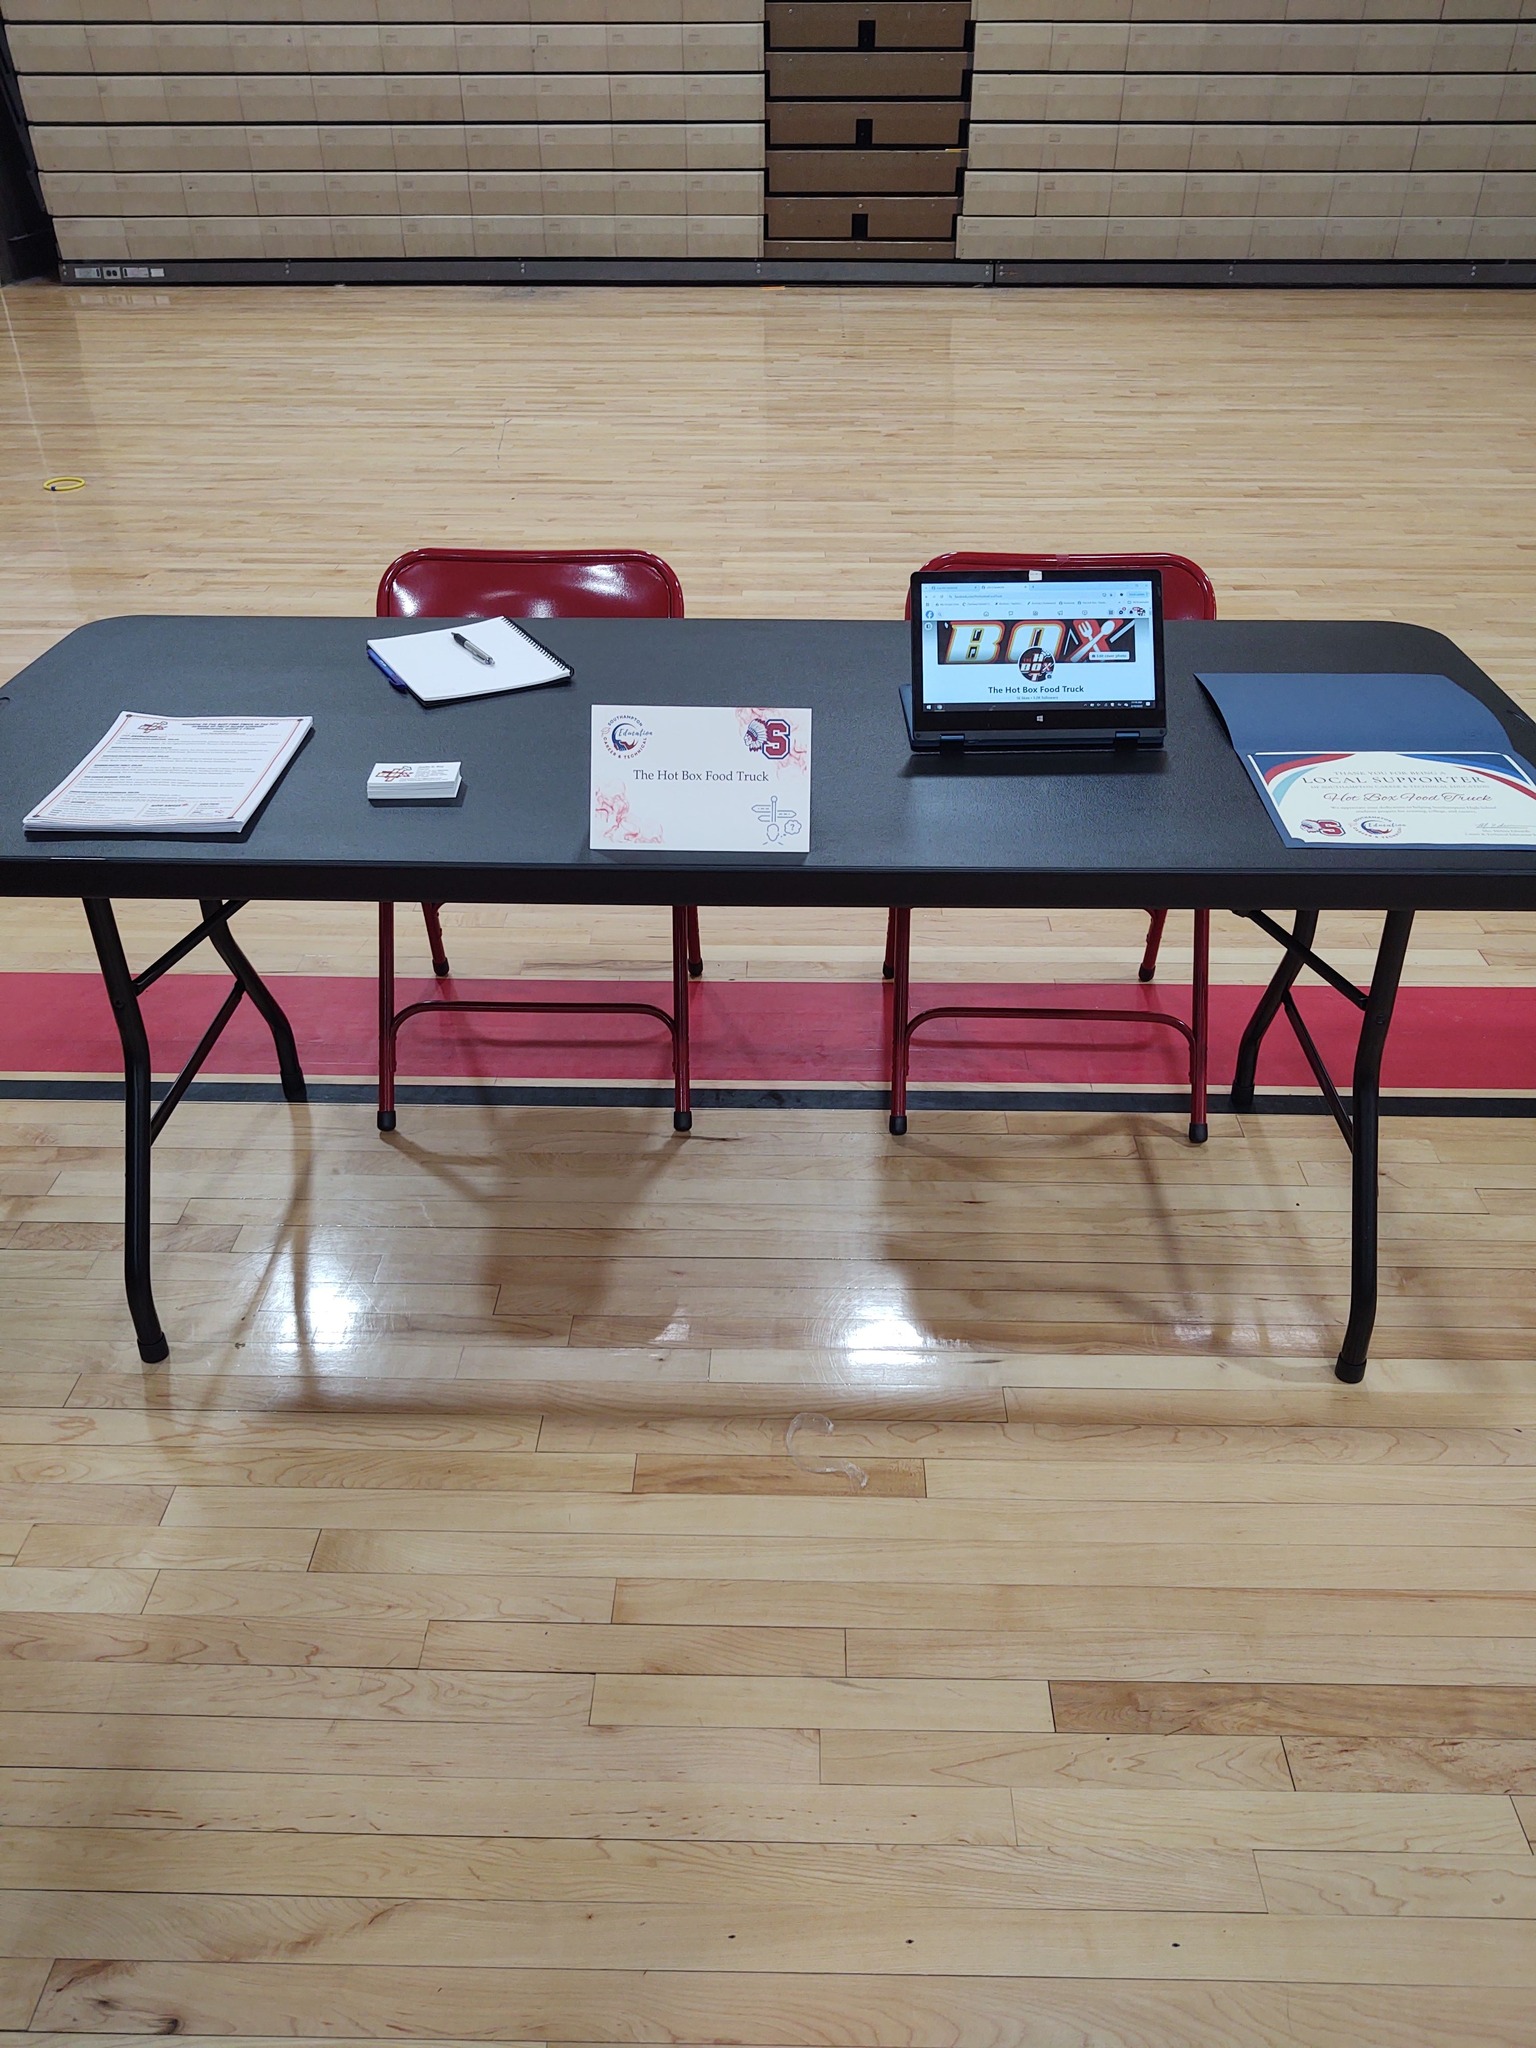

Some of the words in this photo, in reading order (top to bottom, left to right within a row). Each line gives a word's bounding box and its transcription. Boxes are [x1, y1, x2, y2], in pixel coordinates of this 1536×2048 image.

[1005, 686, 1021, 694] Hot
[1022, 686, 1038, 694] Box
[1039, 685, 1060, 693] Food
[1062, 685, 1085, 693] Truck
[607, 714, 643, 727] SOUTHAMPTON
[618, 728, 653, 737] Education
[603, 736, 617, 757] CAREER
[624, 737, 648, 760] TECHNICAL
[632, 769, 655, 781] The
[657, 770, 679, 781] Hot
[681, 770, 703, 781] Box
[705, 770, 733, 781] Food
[736, 771, 770, 782] Truck
[1371, 776, 1486, 784] SUPPORTER
[1323, 793, 1360, 802] Hot
[1363, 793, 1399, 802] Box
[1400, 793, 1440, 802] Food
[1441, 792, 1493, 803] Truck
